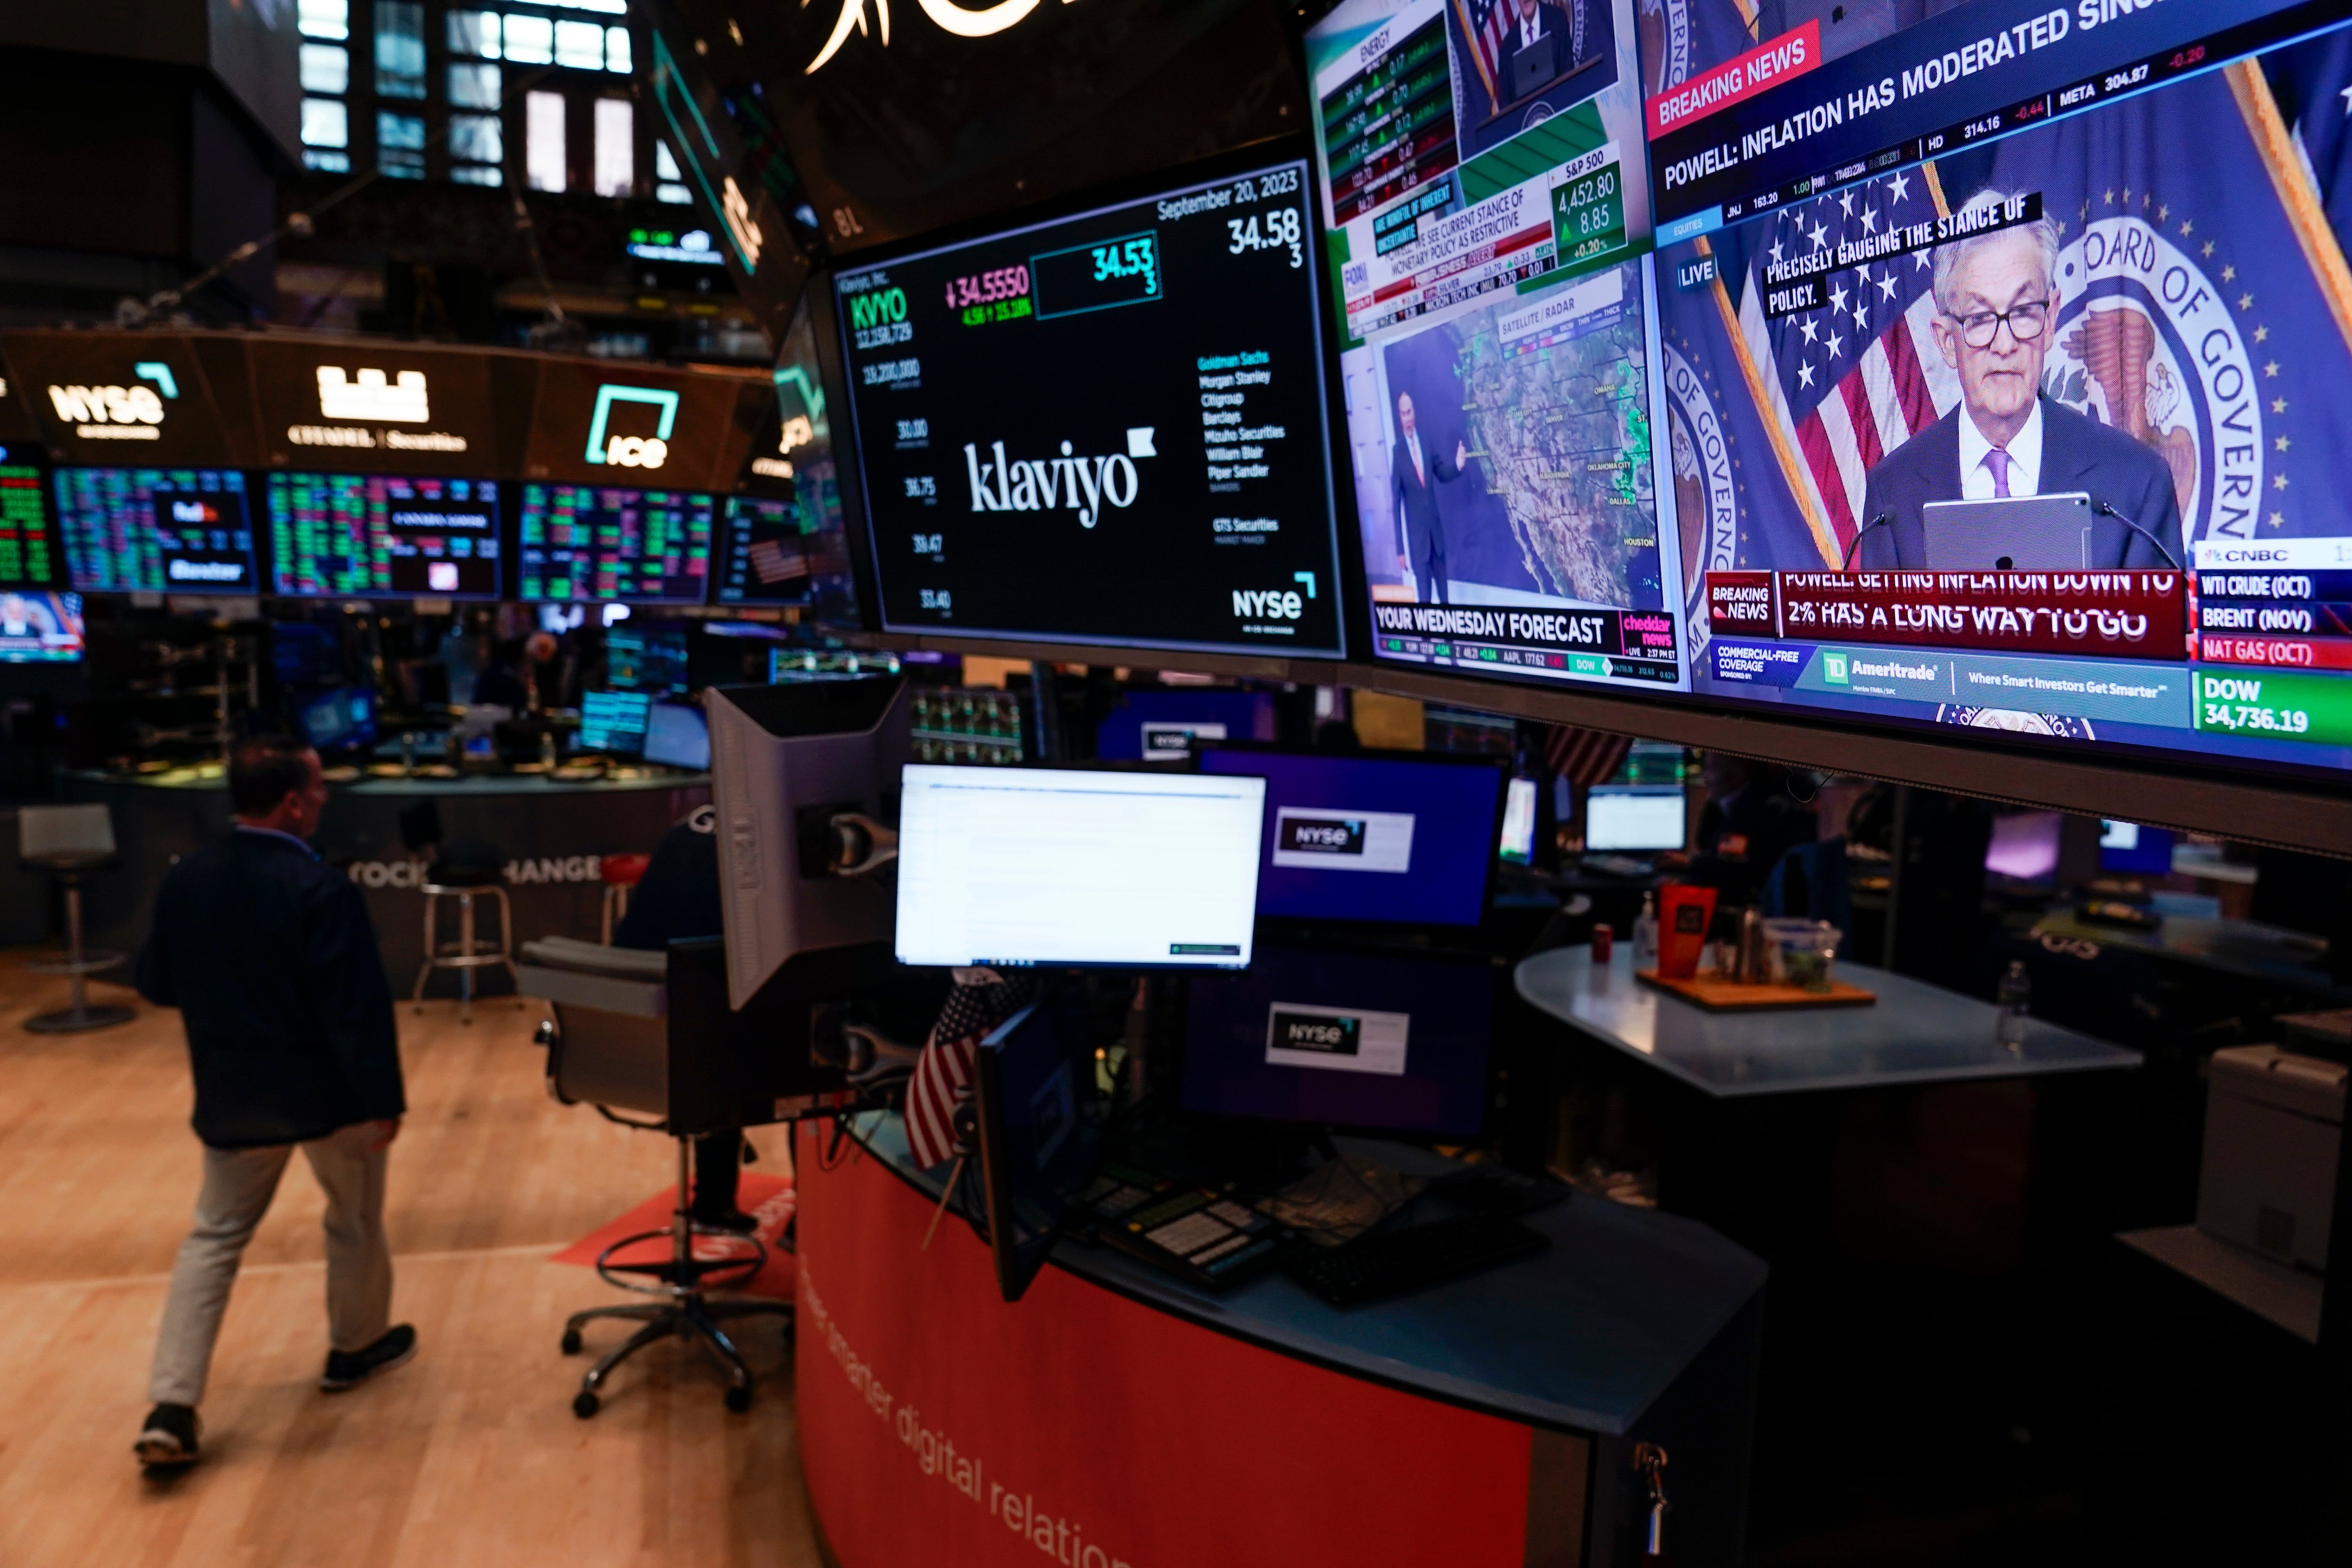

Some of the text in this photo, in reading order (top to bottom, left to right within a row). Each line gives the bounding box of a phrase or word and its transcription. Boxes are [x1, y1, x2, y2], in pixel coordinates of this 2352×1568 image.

[1360, 27, 1391, 63] ENERGY
[1659, 38, 1806, 126] BREAKING NEWS
[1665, 8, 2070, 190] POWELL: INFLATION HAS MODERATED
[1727, 204, 1741, 218] JNJ
[1753, 192, 1779, 209] 163.20
[1793, 181, 1810, 195] 1.00
[1928, 135, 1943, 151] HD
[1964, 116, 2000, 139] 314.16
[2059, 84, 2096, 107] META
[2105, 64, 2149, 91] 304.87
[1566, 150, 1604, 178] S&P 500
[1157, 169, 1299, 221] September 20, 2023
[1558, 172, 1614, 216] 4,452.80
[1427, 189, 1524, 244] SEE CURRENT STANCE OF
[1581, 204, 1609, 234] 8.85
[1674, 218, 1704, 237] EQUITIES
[1227, 207, 1301, 255] 34.58
[1766, 195, 2026, 285] PRECISELY GAUGING THE STANCE OF
[1289, 243, 1303, 269] 3
[1391, 212, 1519, 277] MONETARY POLICY AS RESTRICTIVE
[1574, 238, 1607, 259] +0.20%
[1092, 238, 1154, 282] 34.53
[1144, 271, 1157, 294] 3
[1451, 287, 1467, 302] TECH
[1467, 283, 1479, 298] INC
[1498, 271, 1518, 286] 70.70
[1528, 262, 1544, 276] 0.01
[1681, 261, 1713, 287] LIVE
[956, 265, 1030, 307] 34.5550
[1440, 279, 1459, 293] SILVER
[2162, 266, 2209, 318] OF
[850, 287, 907, 330] KVYO
[1768, 283, 1818, 314] POLICY.
[1578, 316, 1590, 326] THIN
[1604, 305, 1621, 317] THICK
[1197, 349, 1270, 371] Goldman Sachs
[1199, 369, 1271, 390] Morgan Stanley
[1594, 383, 1615, 395] OMAHA
[1200, 392, 1245, 408] Citigroup
[1202, 410, 1242, 425] Barclays
[1238, 424, 1286, 441] Securities
[1205, 447, 1241, 462] William
[1207, 463, 1270, 481] Piper Sandler
[1587, 461, 1631, 472] OKLAHOMA CITY
[963, 439, 1138, 529] klaviyo
[1609, 497, 1632, 506] DALLAS
[1212, 517, 1279, 533] GTS Securities
[1624, 537, 1654, 548] HOUSTON
[2225, 549, 2289, 562] CNBC
[1712, 587, 1769, 602] BREAKING
[2201, 575, 2312, 599] WTI CRUDE (OCT)
[1624, 614, 1670, 632] cheddar
[1727, 602, 1769, 621] NEWS
[1788, 601, 1816, 622] 2%
[1821, 602, 1866, 625] HAS
[1870, 606, 1888, 626] A
[1891, 603, 1963, 629] LONG
[1972, 605, 2036, 632] WAY
[2094, 609, 2148, 637] GO
[2203, 607, 2312, 633] BRENT (NOV)
[1375, 605, 1604, 644] YOUR WEDNESDAY FORECAST
[1642, 632, 1673, 647] news
[1503, 651, 1522, 664] AAPL
[1525, 653, 1545, 666] 177.62
[1576, 659, 1595, 671] DOW
[1629, 646, 1676, 660] LIVE 2:37 PM ET
[1717, 645, 1799, 663] COMMERCIAL-FREE
[2203, 638, 2313, 666] NAT GAS (OCT)
[1718, 659, 1764, 673] COVERAGE
[1719, 670, 1744, 680] SPONSORED
[1826, 658, 1846, 678] TD
[1968, 671, 2001, 686] Where
[2002, 675, 2034, 688] Smart
[2034, 677, 2085, 693] Investors
[2085, 680, 2107, 694] Get
[2203, 677, 2261, 702] DOW
[2204, 703, 2309, 733] 34,736.19
[827, 1319, 894, 1422] smarter
[896, 1404, 983, 1504] digital
